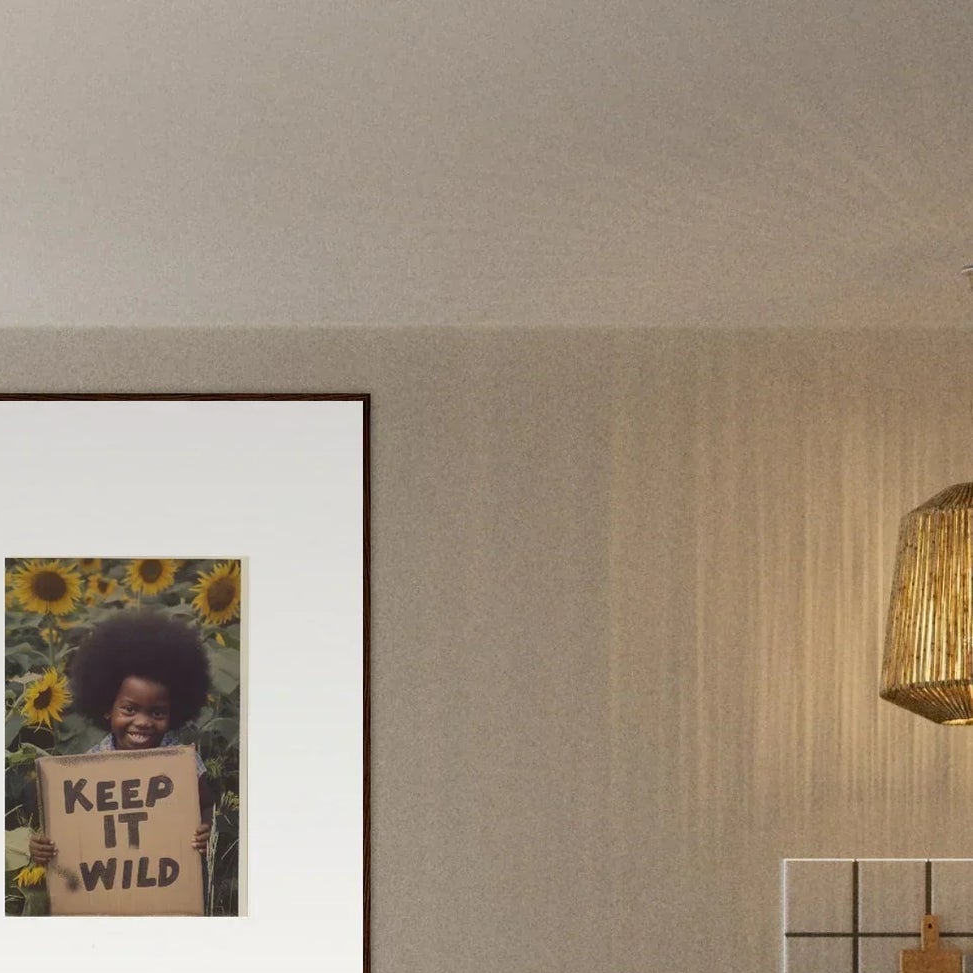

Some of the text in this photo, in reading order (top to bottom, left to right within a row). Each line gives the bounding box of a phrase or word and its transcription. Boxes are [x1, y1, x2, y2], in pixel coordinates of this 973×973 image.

[63, 774, 174, 814] KEEP
[103, 812, 148, 849] IT
[79, 856, 180, 892] WILD
